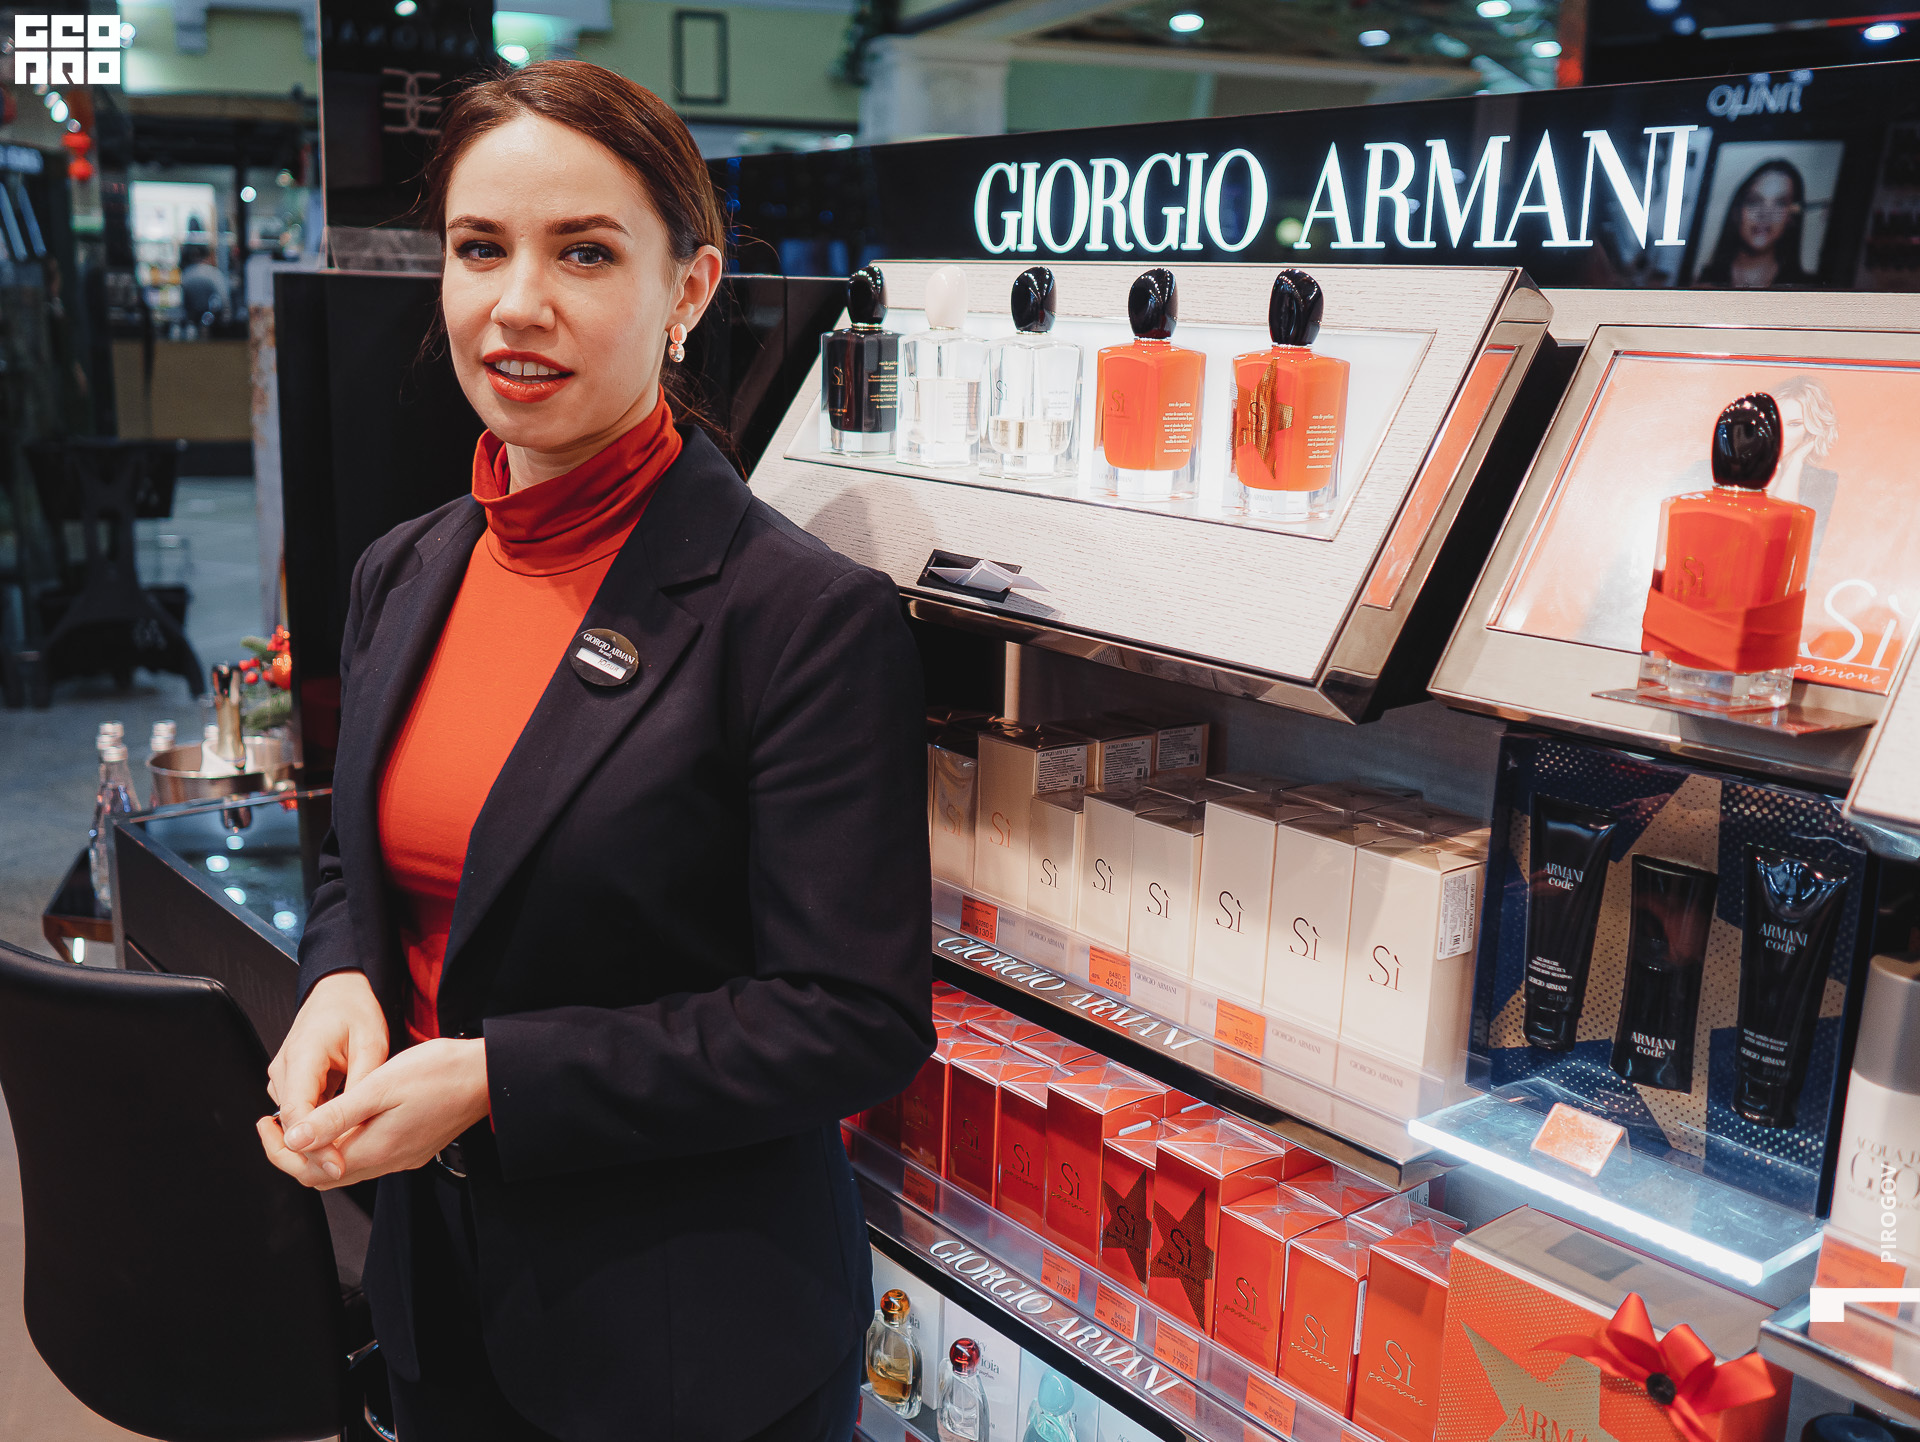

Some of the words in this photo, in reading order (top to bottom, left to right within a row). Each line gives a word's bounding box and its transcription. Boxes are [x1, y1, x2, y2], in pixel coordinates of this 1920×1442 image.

[973, 148, 1269, 254] GIORGIO
[1294, 124, 1699, 250] ARMANI
[583, 633, 611, 651] GIORGIO
[610, 647, 636, 665] ARMANI
[1543, 862, 1584, 882] ARMANI
[1548, 876, 1574, 890] code
[1758, 923, 1808, 947] ARMANI
[1765, 938, 1796, 955] code
[937, 936, 1066, 991] GIORGIO
[1056, 992, 1203, 1050] ARMANI
[1105, 977, 1123, 990] 4240
[1631, 1031, 1676, 1050] ARMANI
[1636, 1045, 1666, 1058] code
[1056, 1282, 1072, 1295] 7767
[929, 1240, 1053, 1314] GIORGIO
[1044, 1316, 1183, 1396] ARMANI
[1110, 1317, 1127, 1332] 5512
[981, 1355, 1000, 1374] ioia
[1171, 1355, 1189, 1371] 7767
[1510, 1402, 1589, 1442] ARM
